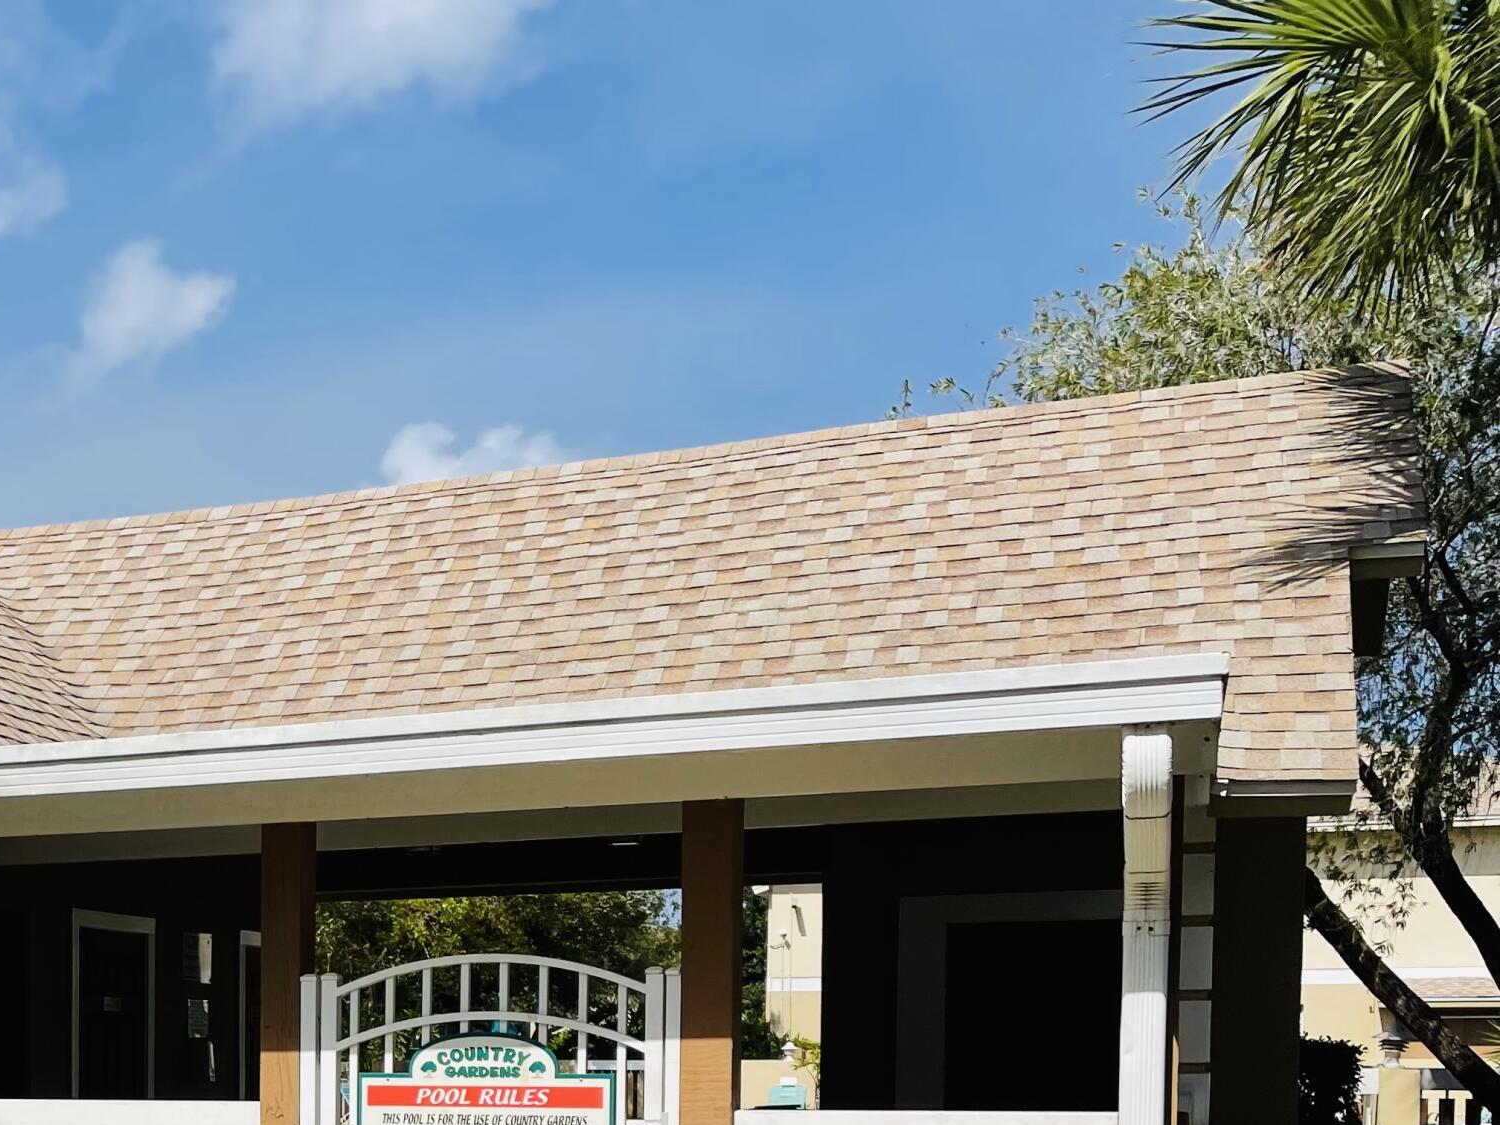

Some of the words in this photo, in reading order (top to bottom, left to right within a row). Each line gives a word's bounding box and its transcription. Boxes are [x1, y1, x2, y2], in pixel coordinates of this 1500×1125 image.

[437, 1046, 532, 1066] COUNTRY
[445, 1066, 521, 1078] GARDENS
[416, 1088, 470, 1105] POOL
[479, 1089, 550, 1105] RULES
[382, 1113, 400, 1125] THIS
[403, 1114, 424, 1125] POOL
[426, 1114, 435, 1125] IS
[438, 1114, 454, 1125] FOR
[457, 1114, 472, 1125] THE
[473, 1115, 489, 1125] USE
[492, 1115, 502, 1125] OF
